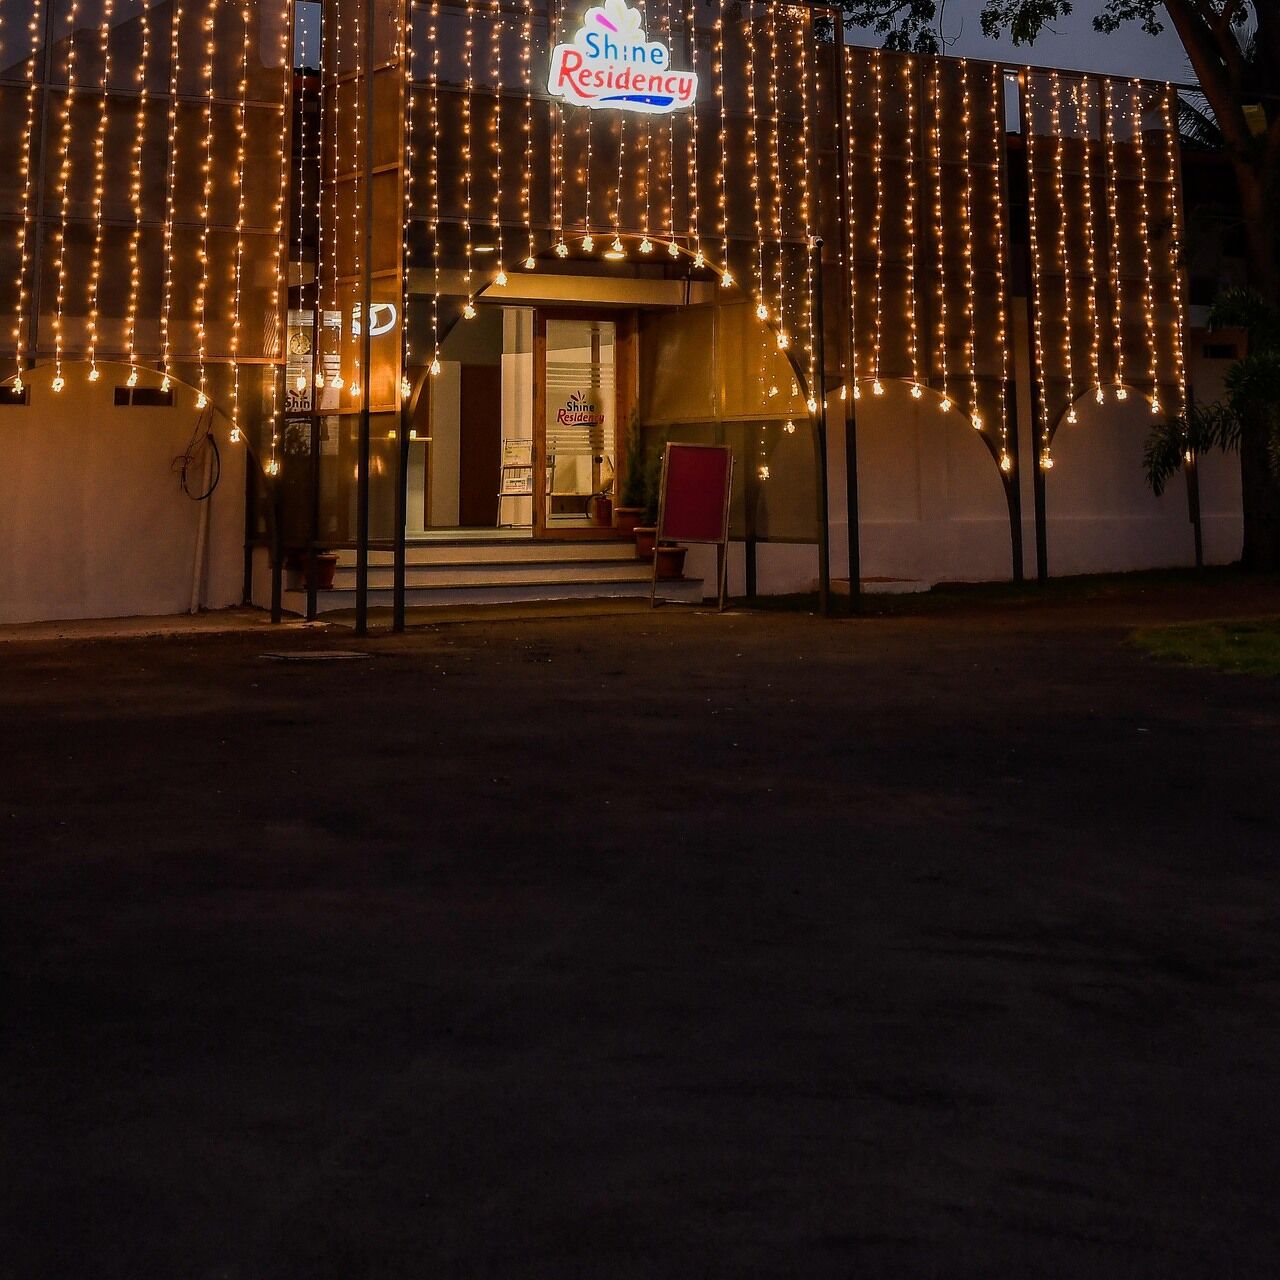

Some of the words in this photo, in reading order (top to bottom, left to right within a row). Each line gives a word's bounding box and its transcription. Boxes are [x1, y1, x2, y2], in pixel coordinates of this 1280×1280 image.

[585, 32, 663, 65] Shine
[558, 50, 693, 100] Residency
[284, 396, 310, 409] Shin
[566, 401, 595, 412] Shine
